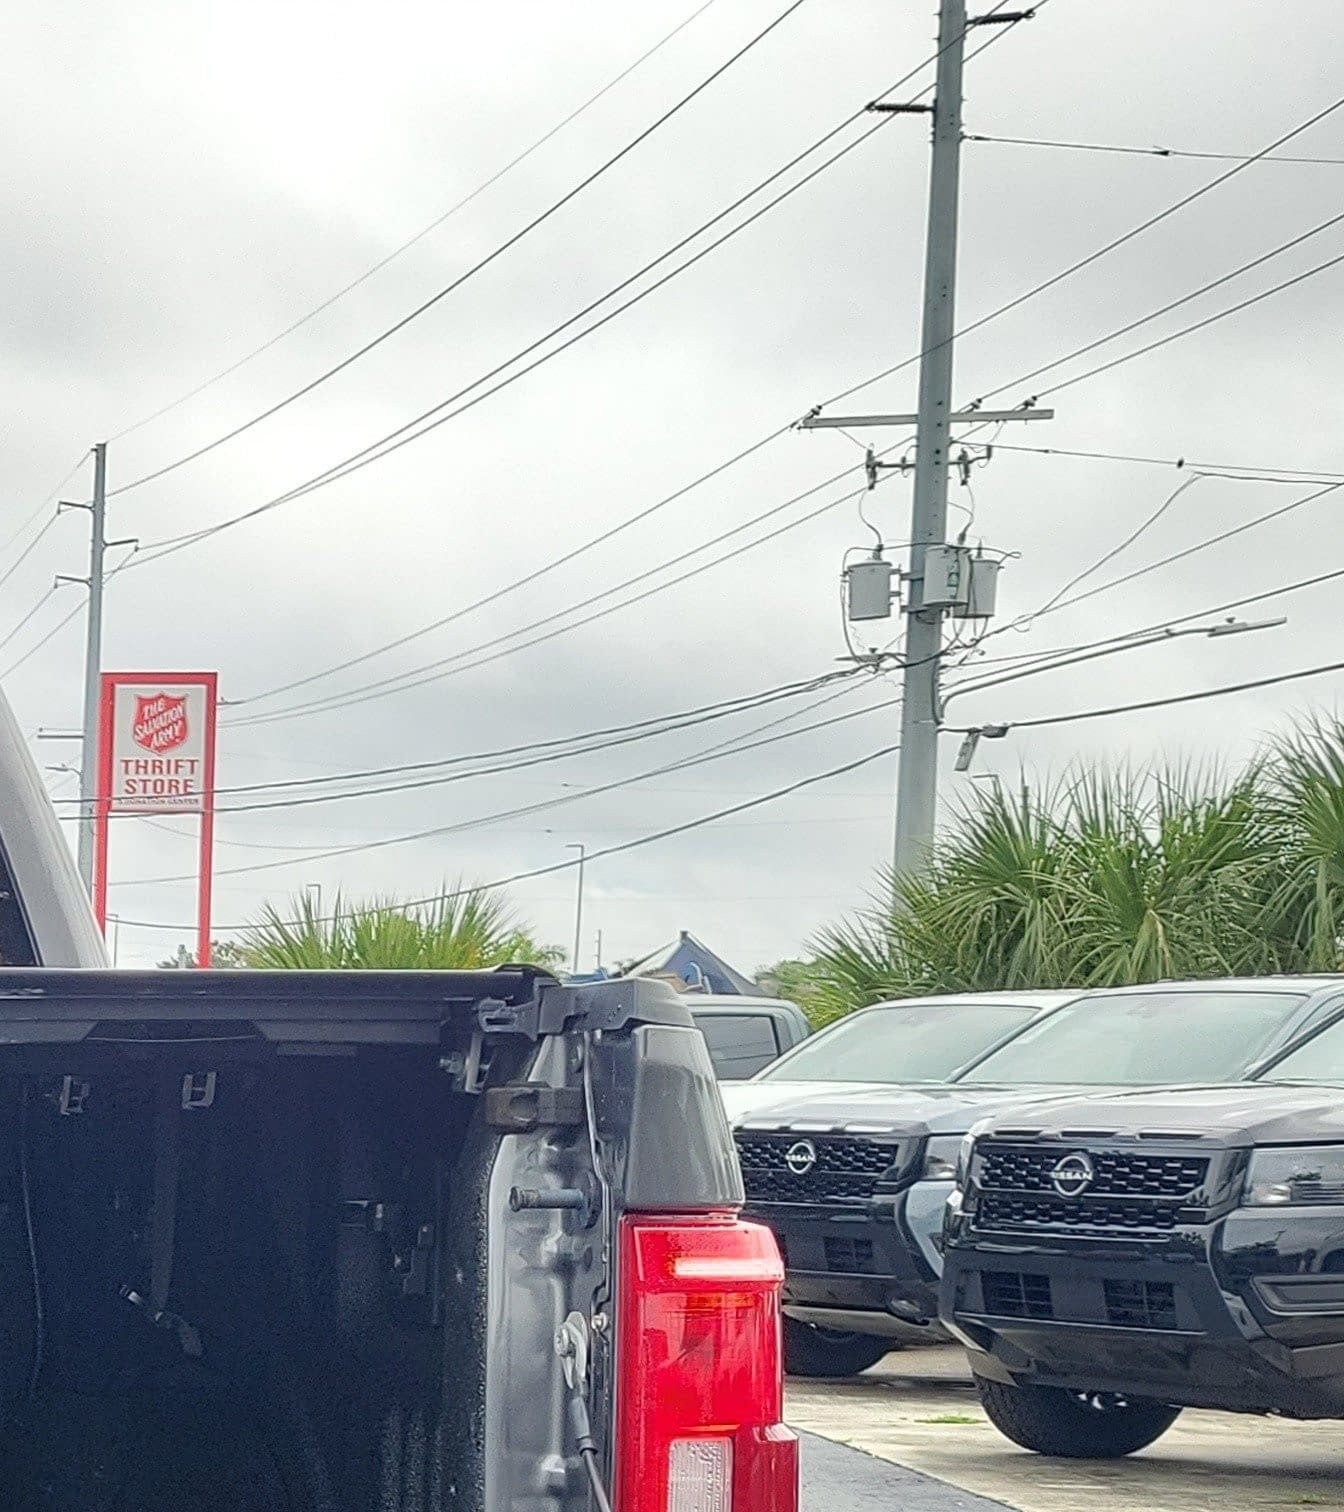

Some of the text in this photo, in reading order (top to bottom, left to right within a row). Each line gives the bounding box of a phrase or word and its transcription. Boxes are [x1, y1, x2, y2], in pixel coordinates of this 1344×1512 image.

[143, 698, 165, 720] THE
[120, 759, 199, 775] THRIFT
[124, 778, 194, 795] STORE
